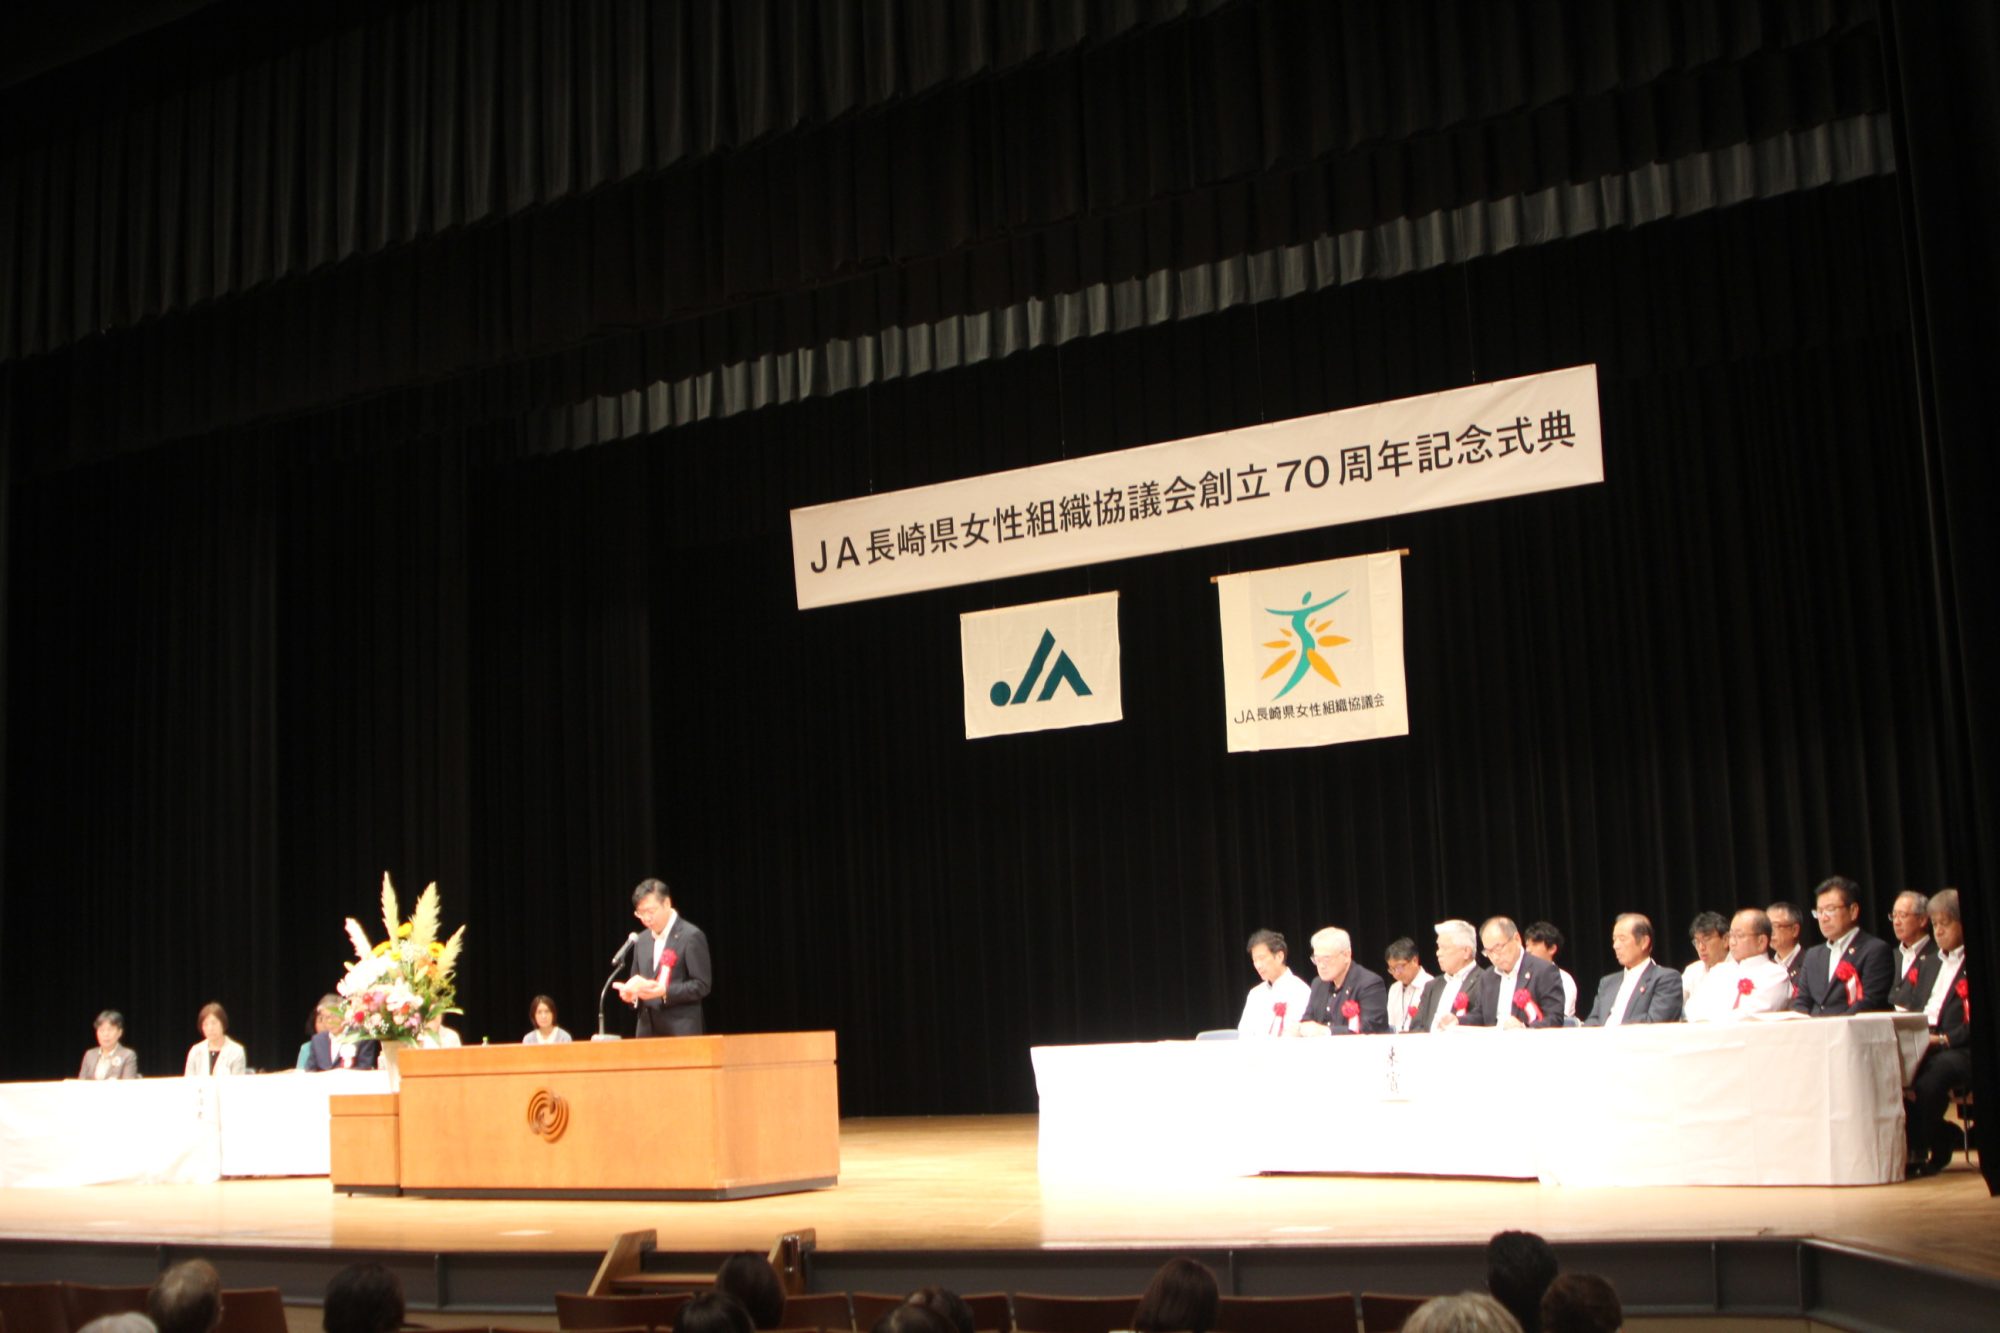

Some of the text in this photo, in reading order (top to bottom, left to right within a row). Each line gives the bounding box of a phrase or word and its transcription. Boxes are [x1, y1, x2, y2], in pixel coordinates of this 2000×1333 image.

[811, 410, 1576, 574] JA長崎県女性組織協議会創立70周年記念式典
[1234, 693, 1385, 724] JA長崎県女性組織協議会
